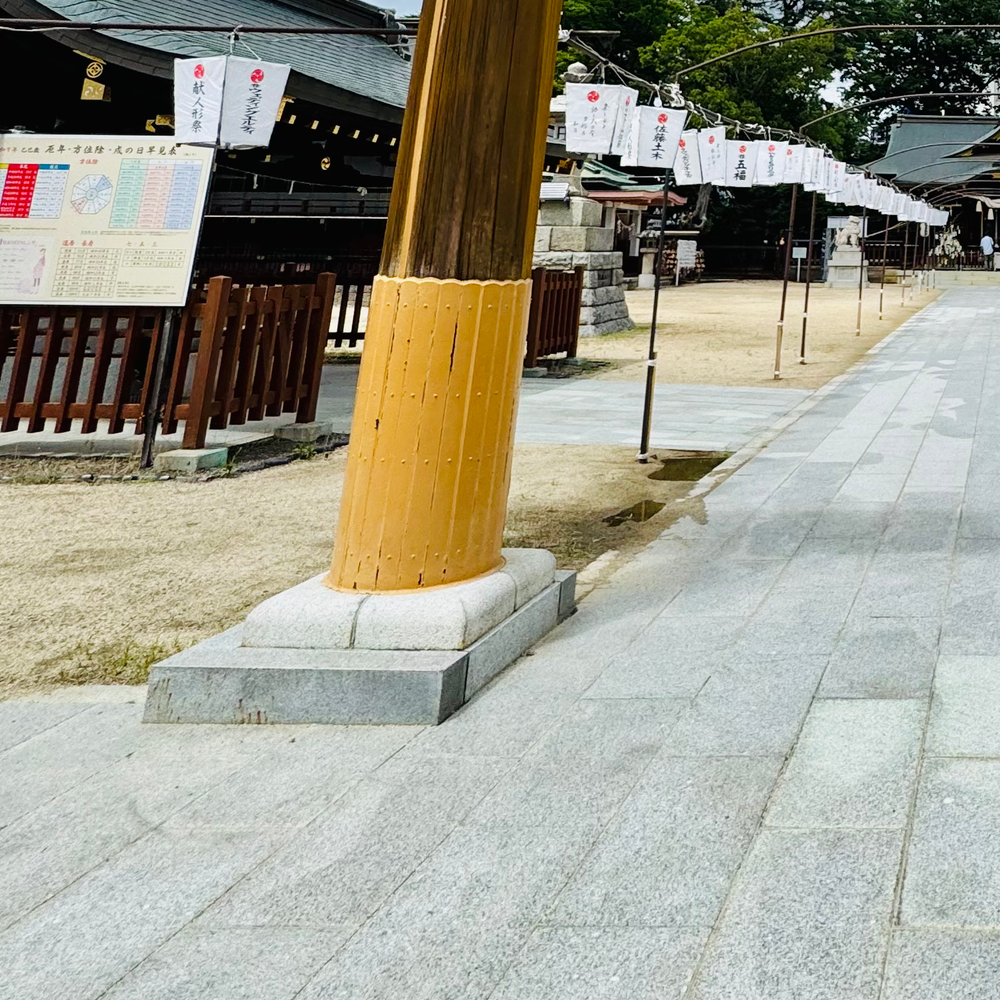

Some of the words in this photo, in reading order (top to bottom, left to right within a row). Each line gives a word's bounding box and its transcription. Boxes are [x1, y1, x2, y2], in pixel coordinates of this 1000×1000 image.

[191, 81, 205, 133] 献人形祭
[651, 125, 669, 161] 佐藤土木
